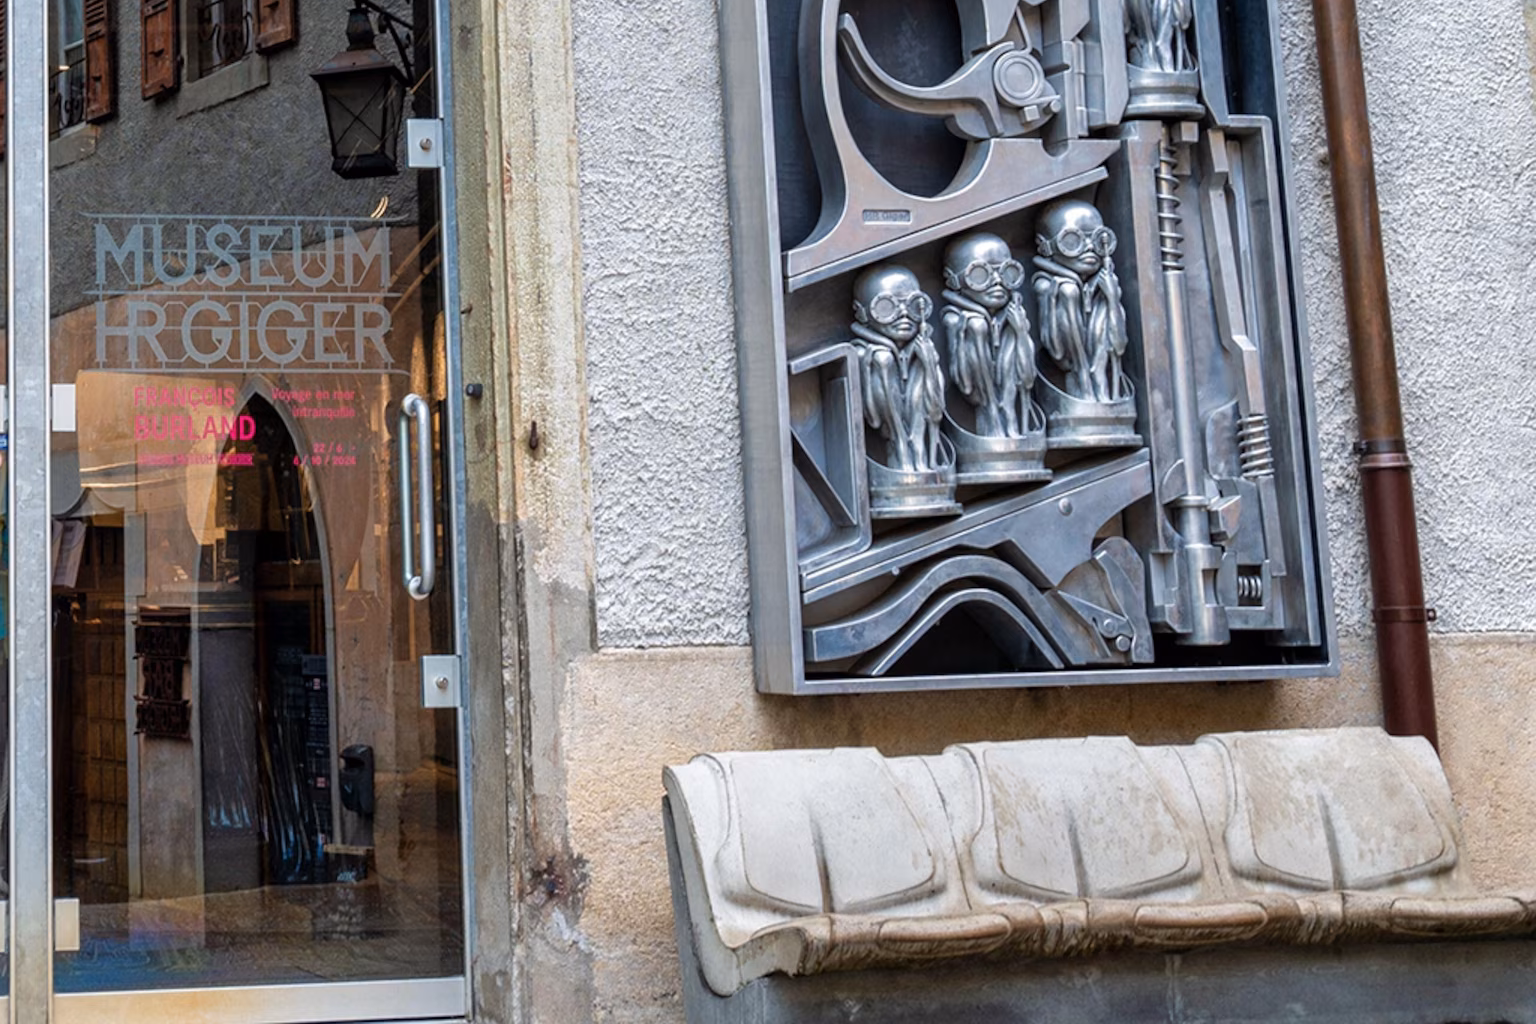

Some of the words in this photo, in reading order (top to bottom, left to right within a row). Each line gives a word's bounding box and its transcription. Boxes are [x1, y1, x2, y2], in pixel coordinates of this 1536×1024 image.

[94, 223, 392, 288] MUSEUM
[180, 299, 395, 365] GIGER
[134, 385, 236, 411] FRANÇOIS
[271, 387, 311, 403] Voyage
[134, 414, 257, 441] BURLAND
[332, 454, 357, 465] 2024
